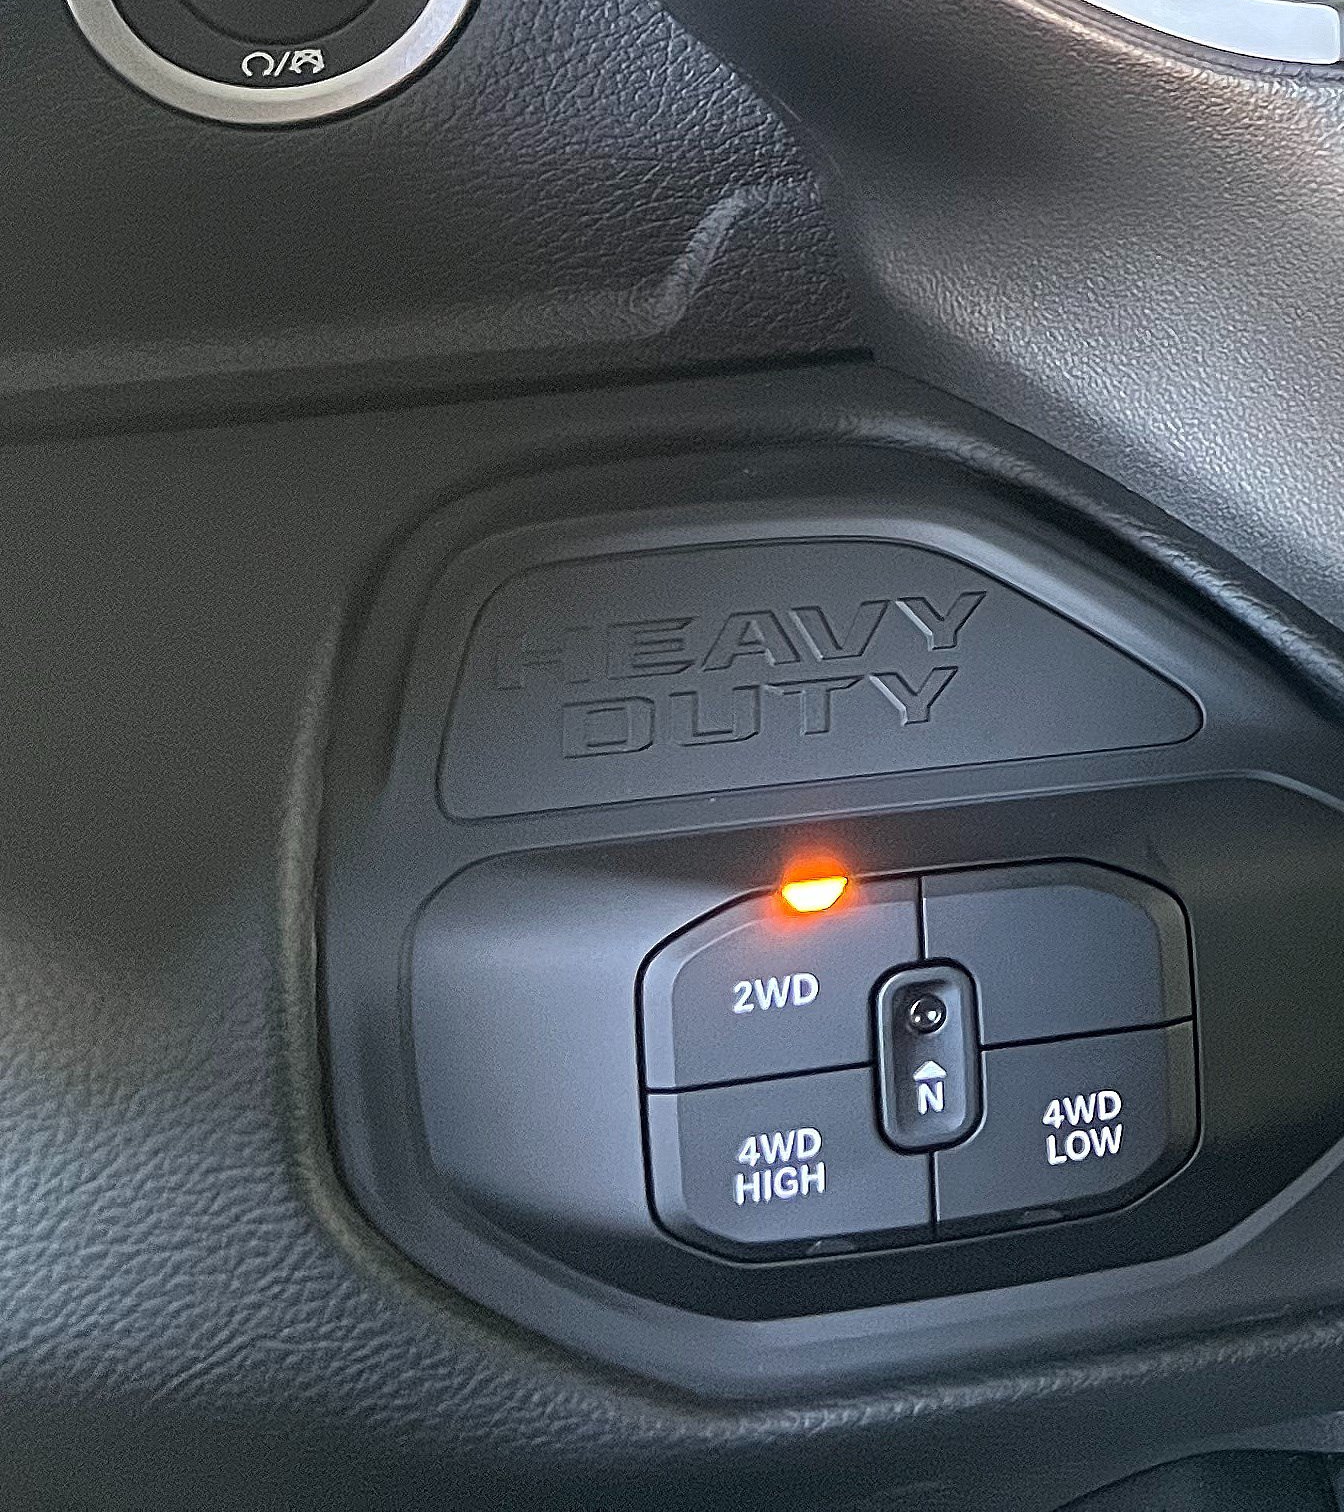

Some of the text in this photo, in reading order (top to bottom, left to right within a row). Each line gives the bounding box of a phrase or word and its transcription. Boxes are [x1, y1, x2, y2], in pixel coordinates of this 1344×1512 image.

[494, 590, 988, 690] HEAVY
[561, 666, 960, 760] DUTY
[731, 971, 820, 1016] 2WD
[916, 1082, 946, 1115] N
[1042, 1088, 1123, 1130] 4WD
[737, 1126, 822, 1168] 4WD
[1045, 1123, 1124, 1167] LOW
[734, 1161, 827, 1207] HIGH
